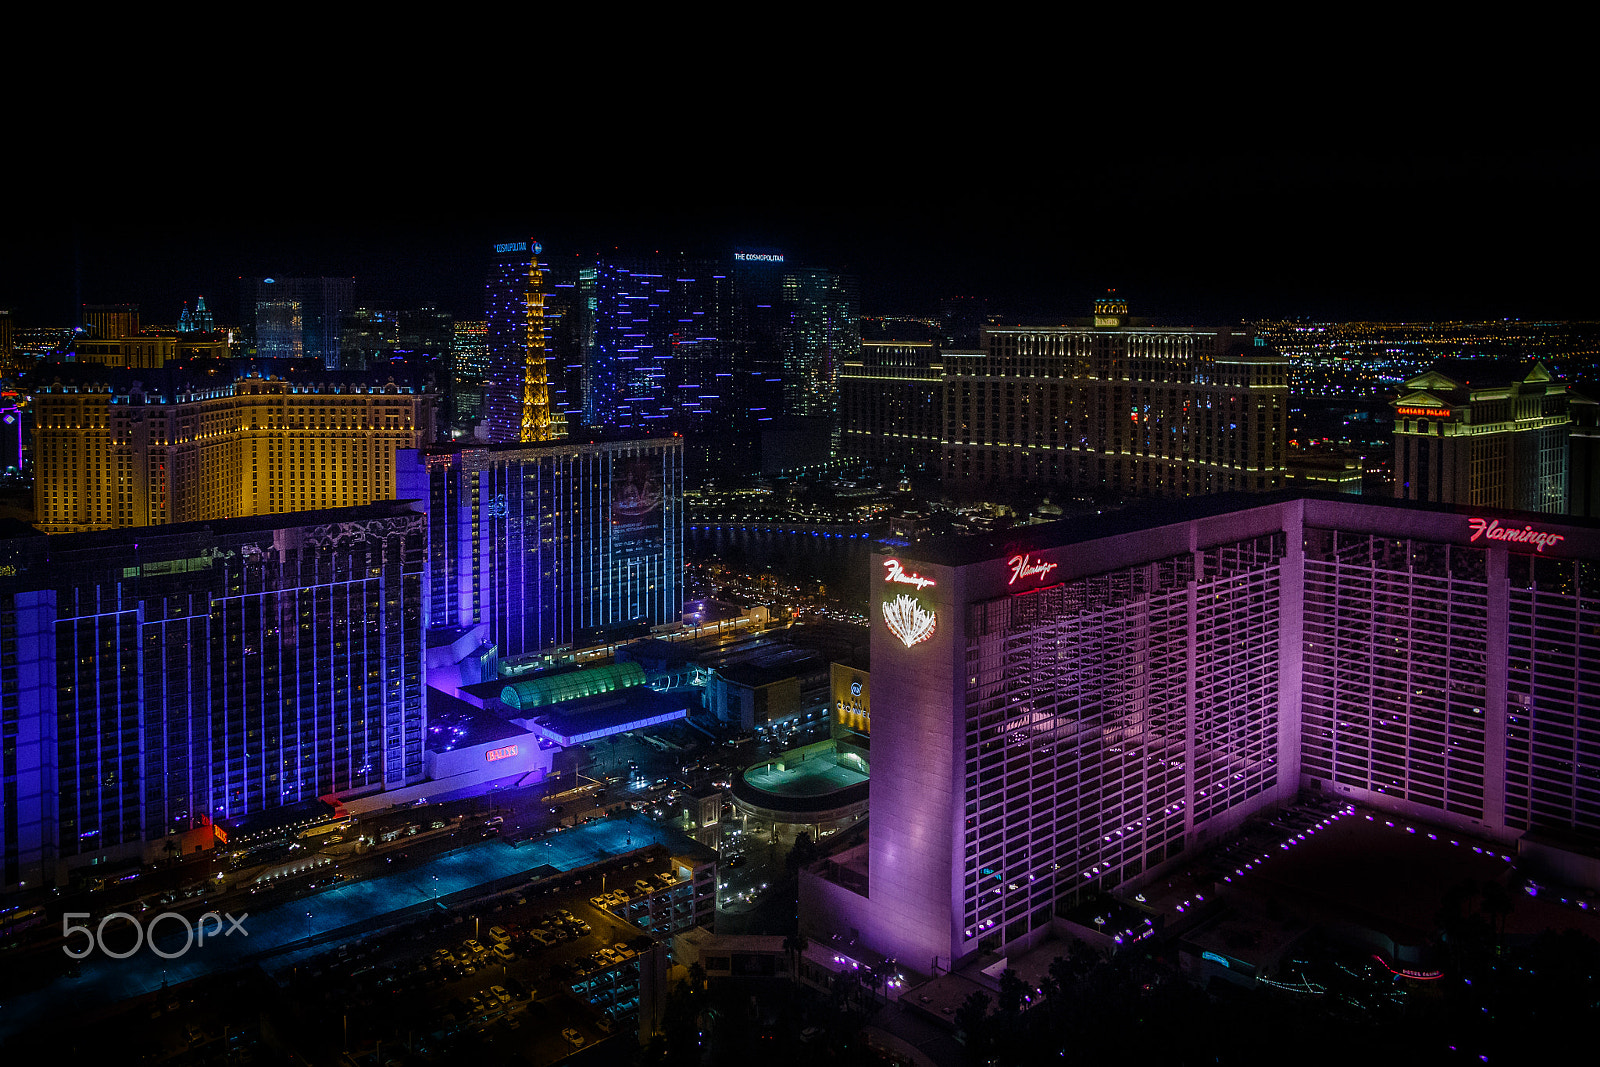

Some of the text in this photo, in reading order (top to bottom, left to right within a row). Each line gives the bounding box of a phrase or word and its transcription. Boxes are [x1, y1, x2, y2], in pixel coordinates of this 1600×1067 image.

[746, 253, 784, 262] COSMOPOLITAN
[1397, 407, 1451, 417] CAESARS PALACE
[1467, 517, 1565, 552] Flamingo
[884, 559, 936, 591] Flamingo
[1008, 554, 1058, 585] Flamingo
